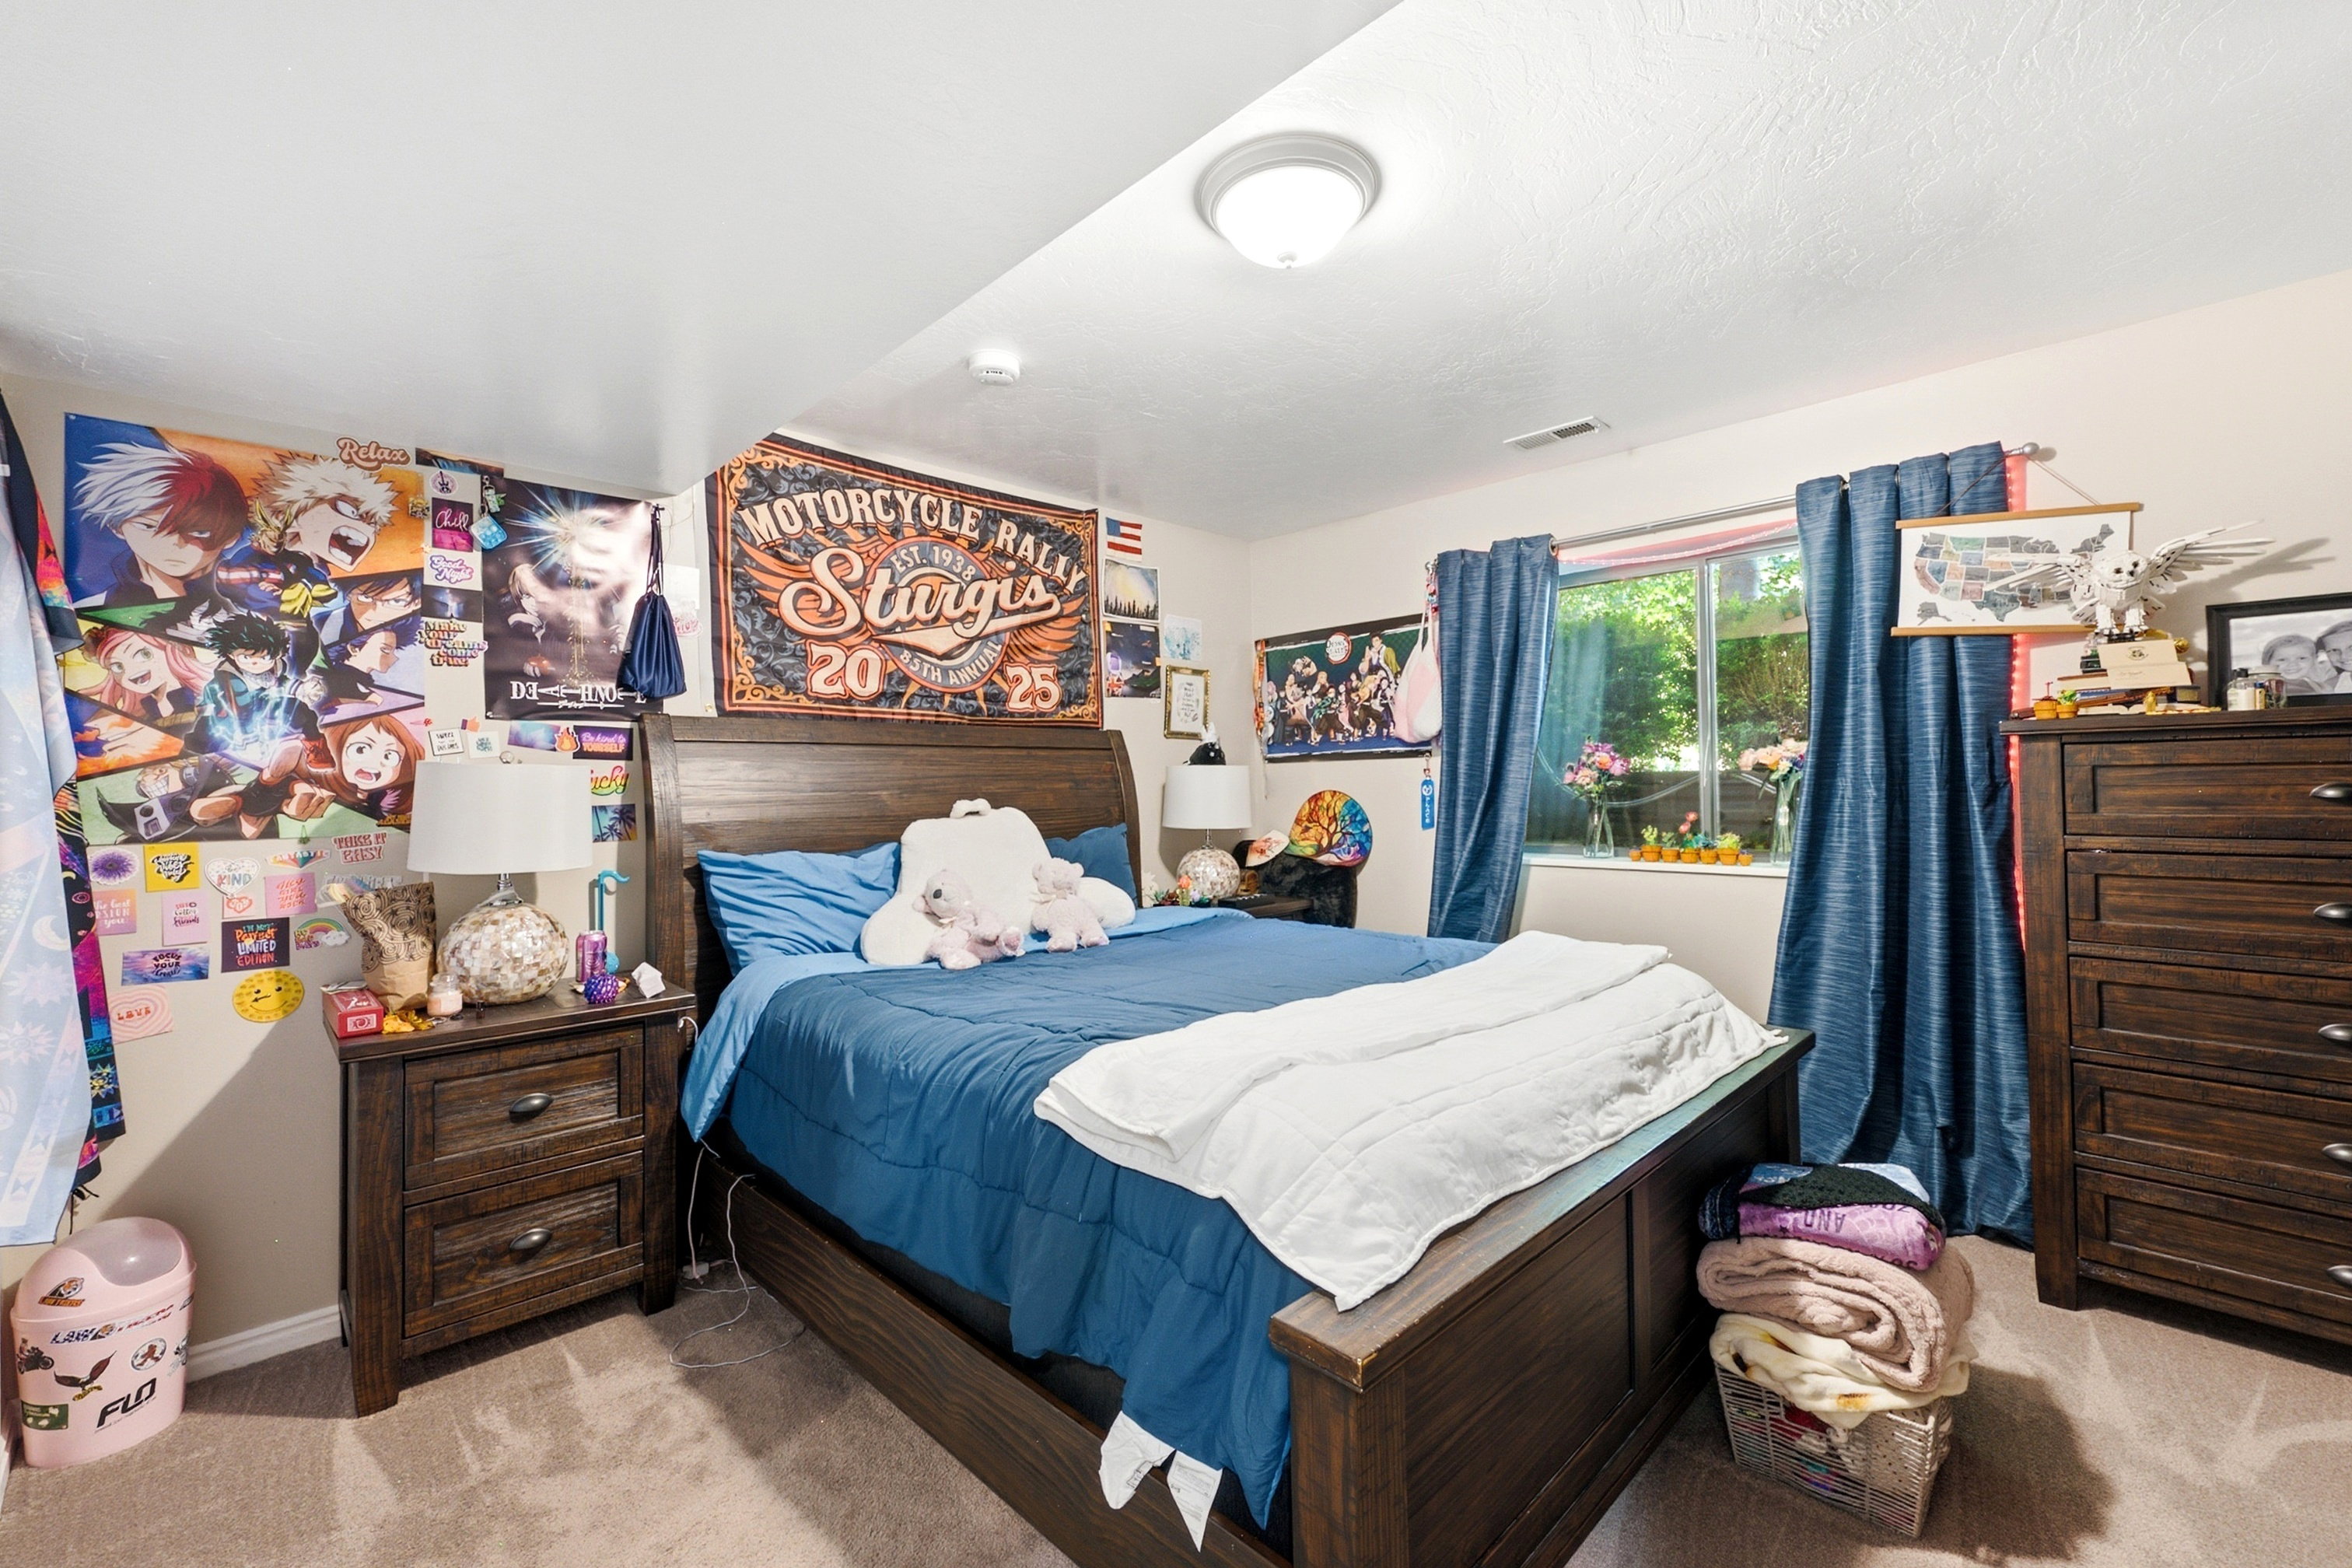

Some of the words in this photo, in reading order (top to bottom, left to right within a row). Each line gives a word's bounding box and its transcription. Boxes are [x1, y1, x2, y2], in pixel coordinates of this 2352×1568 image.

[337, 438, 411, 471] Relax
[436, 509, 470, 532] Chill
[739, 488, 984, 550] MOTORCYCLE
[996, 518, 1087, 596] RALLY
[890, 545, 928, 574] EST.
[933, 546, 976, 582] 1938
[779, 547, 1062, 655] Sturgis
[807, 640, 886, 698] 20
[1003, 663, 1063, 712] 25
[899, 648, 943, 684] 85TH
[947, 640, 1003, 685] ANNUAL
[582, 742, 626, 753] YOURSELF
[590, 765, 630, 796] ucky
[216, 873, 253, 887] KIND
[152, 952, 183, 962] FOCUS
[237, 939, 277, 956] LIMITED
[237, 953, 275, 968] EDITION
[117, 1006, 151, 1021] LOVE
